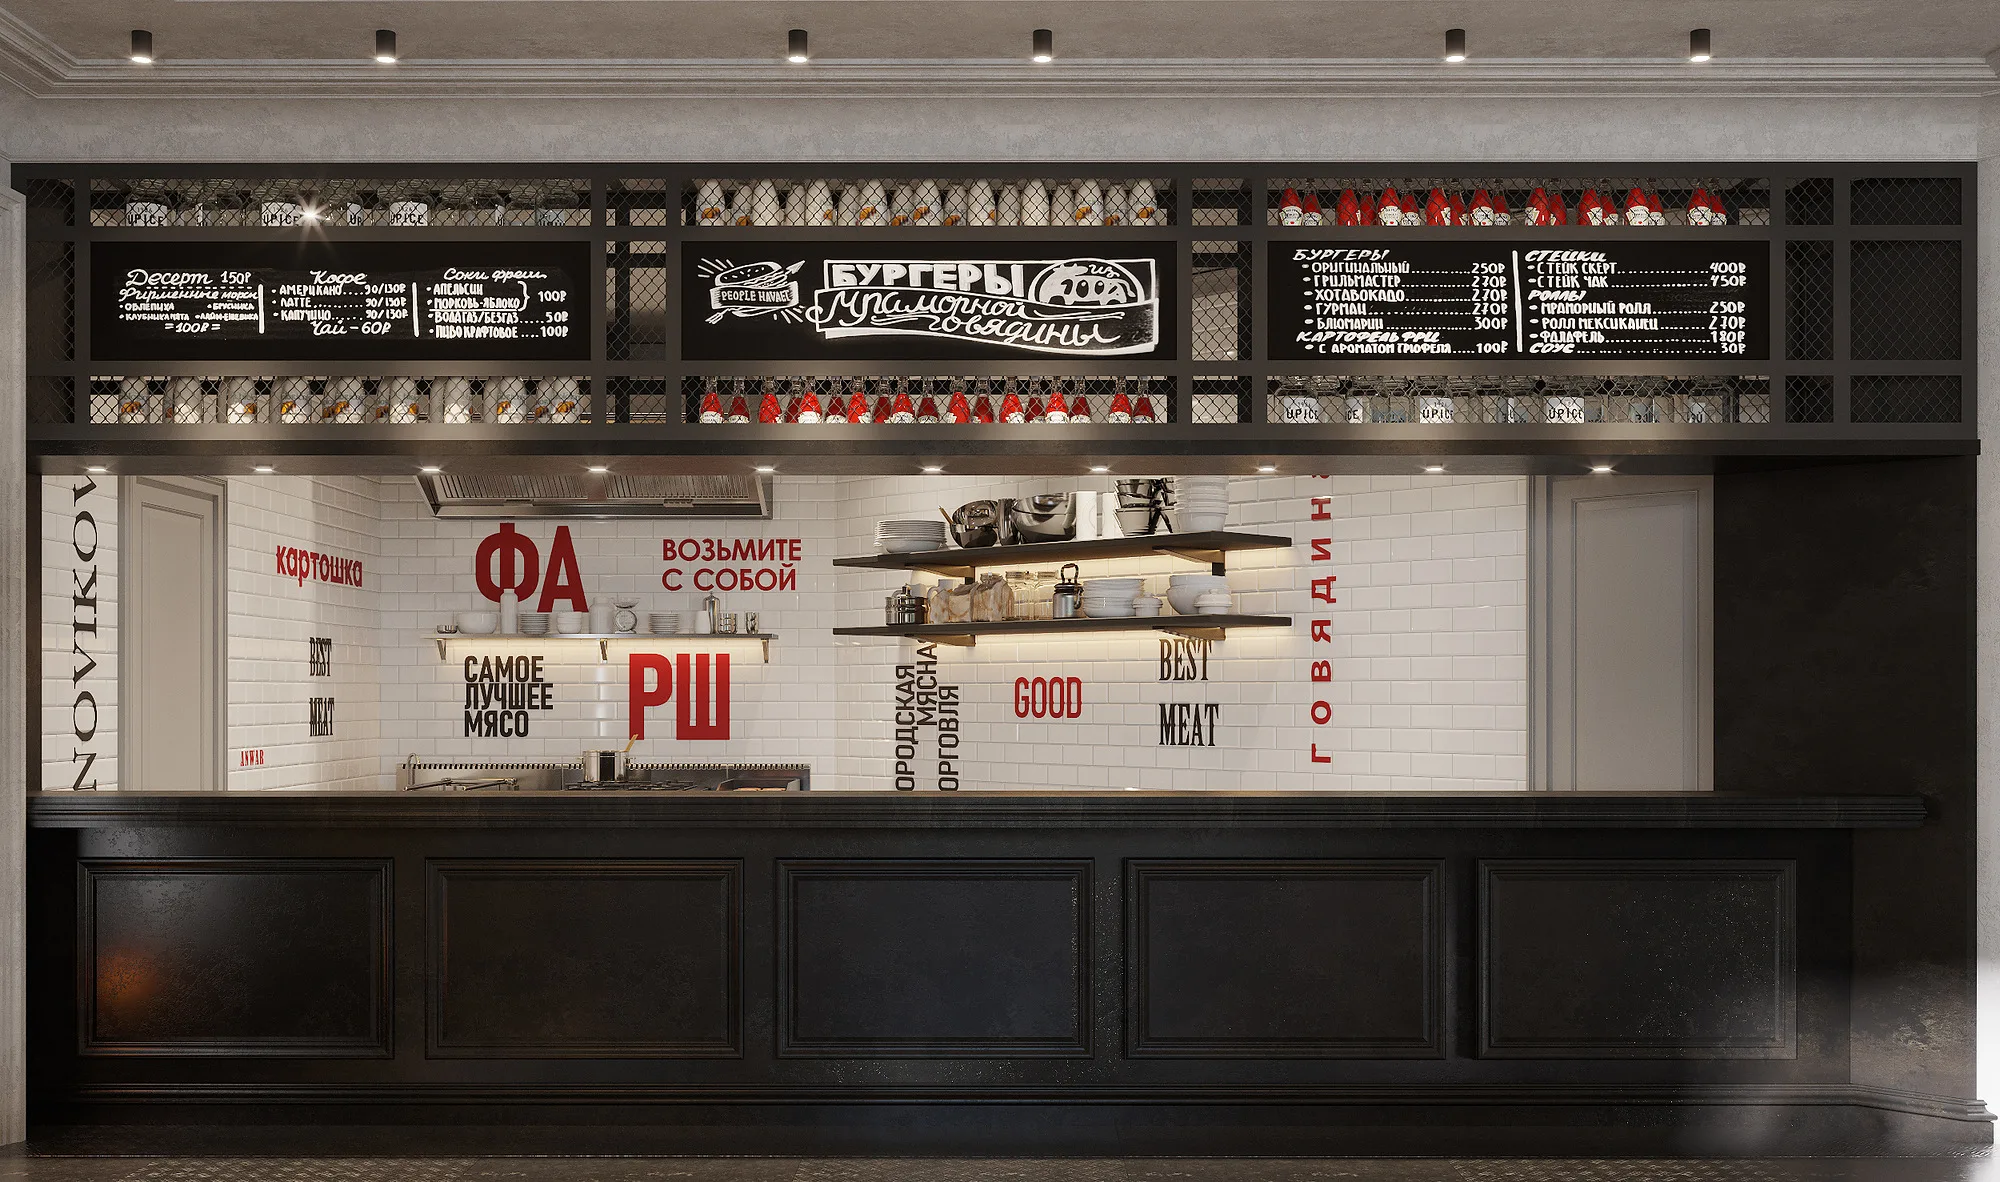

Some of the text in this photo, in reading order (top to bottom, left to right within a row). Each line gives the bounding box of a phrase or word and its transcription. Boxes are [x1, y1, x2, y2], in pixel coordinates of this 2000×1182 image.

[1292, 249, 1391, 261] БУРГЕРЫ
[1525, 248, 1607, 262] СТЕЙКИ
[443, 267, 490, 280] Соки
[1311, 261, 1410, 274] ОРИГИНАЛЬНЫЙ
[1537, 262, 1578, 274] СТЕЙК
[1581, 262, 1617, 274] СКЕРТ
[125, 268, 213, 287] Десерт
[309, 270, 368, 288] Кофе
[832, 263, 1024, 298] БУРГЕРЫ
[1314, 275, 1401, 287] ГРИЛЬМАСТЕР
[1537, 274, 1580, 288] СТЕЙК
[1583, 275, 1609, 288] ЧАК
[118, 287, 219, 302] Фирменные
[279, 284, 342, 296] АМЕРИКАНО
[433, 283, 484, 296] АПЕЛЬСИН
[721, 290, 756, 302] PEOPLE
[1528, 290, 1587, 301] РОЛЛЫ
[280, 297, 312, 308] ЛАТТЕ
[1316, 303, 1367, 315] ГУРМАН
[1541, 301, 1616, 315] МРАМОРНЫЙ
[1618, 302, 1652, 315] РОЛЛ
[309, 319, 348, 336] Чай
[926, 314, 1121, 346] говядины
[1317, 317, 1384, 330] БЛЮМАРИН
[1542, 317, 1576, 330] РОЛЛ
[1578, 317, 1659, 330] МЕКСИКАНЕЦ
[1296, 331, 1440, 343] КАРТОФЕЛЬ ФРИ
[1540, 331, 1605, 343] ФАЛАФЕЛЬ
[1331, 344, 1395, 354] АРОМАТОМ
[1529, 343, 1576, 354] СОУС
[662, 539, 802, 562] ВОЗЬМИТЕ
[276, 545, 362, 587] картошка
[475, 522, 589, 613] ФА
[662, 562, 797, 592] С СОБОЙ
[1311, 475, 1337, 764] ГОВЯДИН
[309, 637, 332, 677] BEST
[1158, 638, 1213, 682] BEST
[464, 656, 544, 682] САМОЕ
[916, 638, 938, 726] МЯСНА
[464, 683, 554, 710] ЛУЧШЕЕ
[629, 653, 730, 740] РШ
[1014, 676, 1083, 719] GOOD
[309, 697, 335, 737] MEAT
[464, 710, 529, 738] МЯСО
[1158, 702, 1220, 747] MEAT
[895, 665, 919, 791] ОРОДСКАЯ
[938, 685, 959, 791] ОРГОВЛЯ
